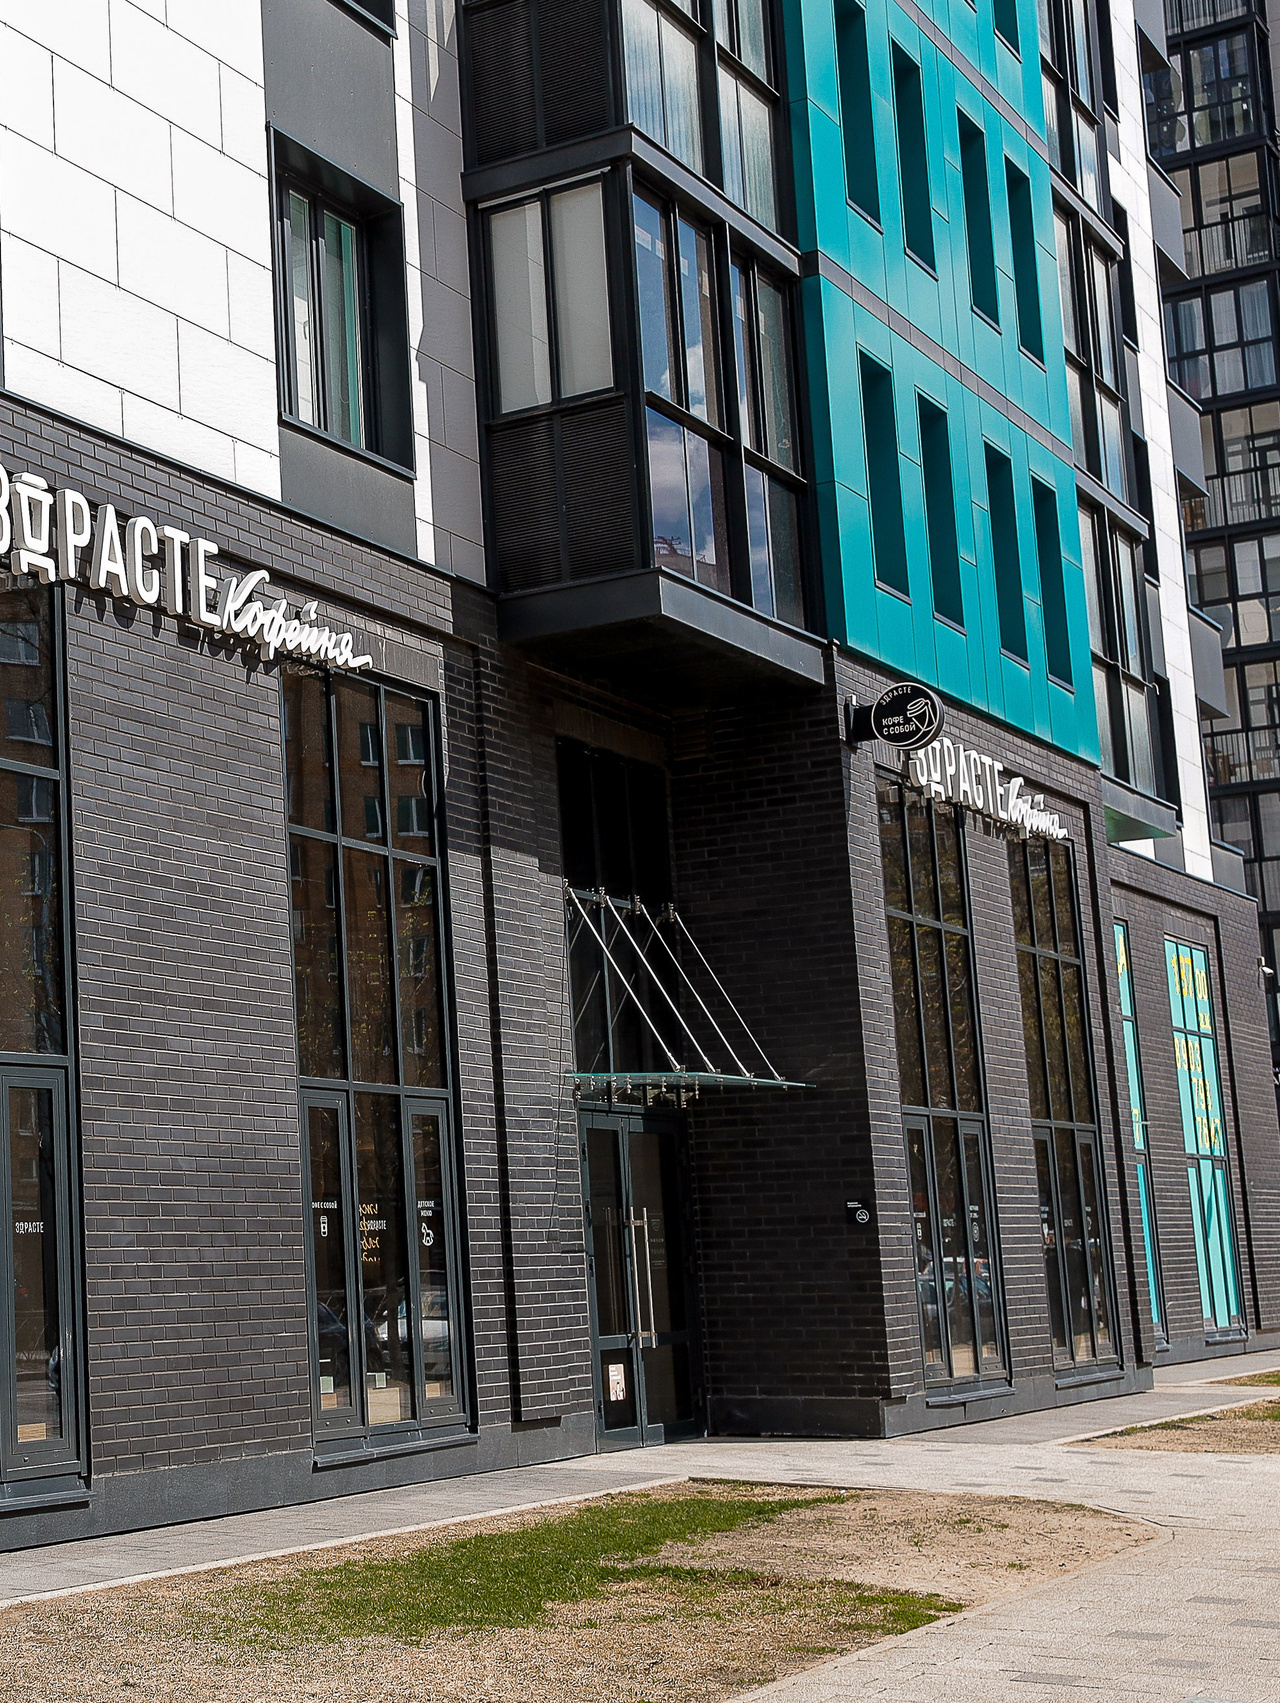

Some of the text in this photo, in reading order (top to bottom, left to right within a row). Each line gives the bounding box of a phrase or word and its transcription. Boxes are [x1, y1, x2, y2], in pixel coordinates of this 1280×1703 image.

[880, 686, 912, 706] ЗДРАСТЕ
[882, 716, 904, 726] КОФЕ
[889, 722, 916, 734] СОБОЙ
[908, 737, 1008, 823] ЗДРАСТЕ
[15, 1221, 44, 1234] ЗДРАСТЕ
